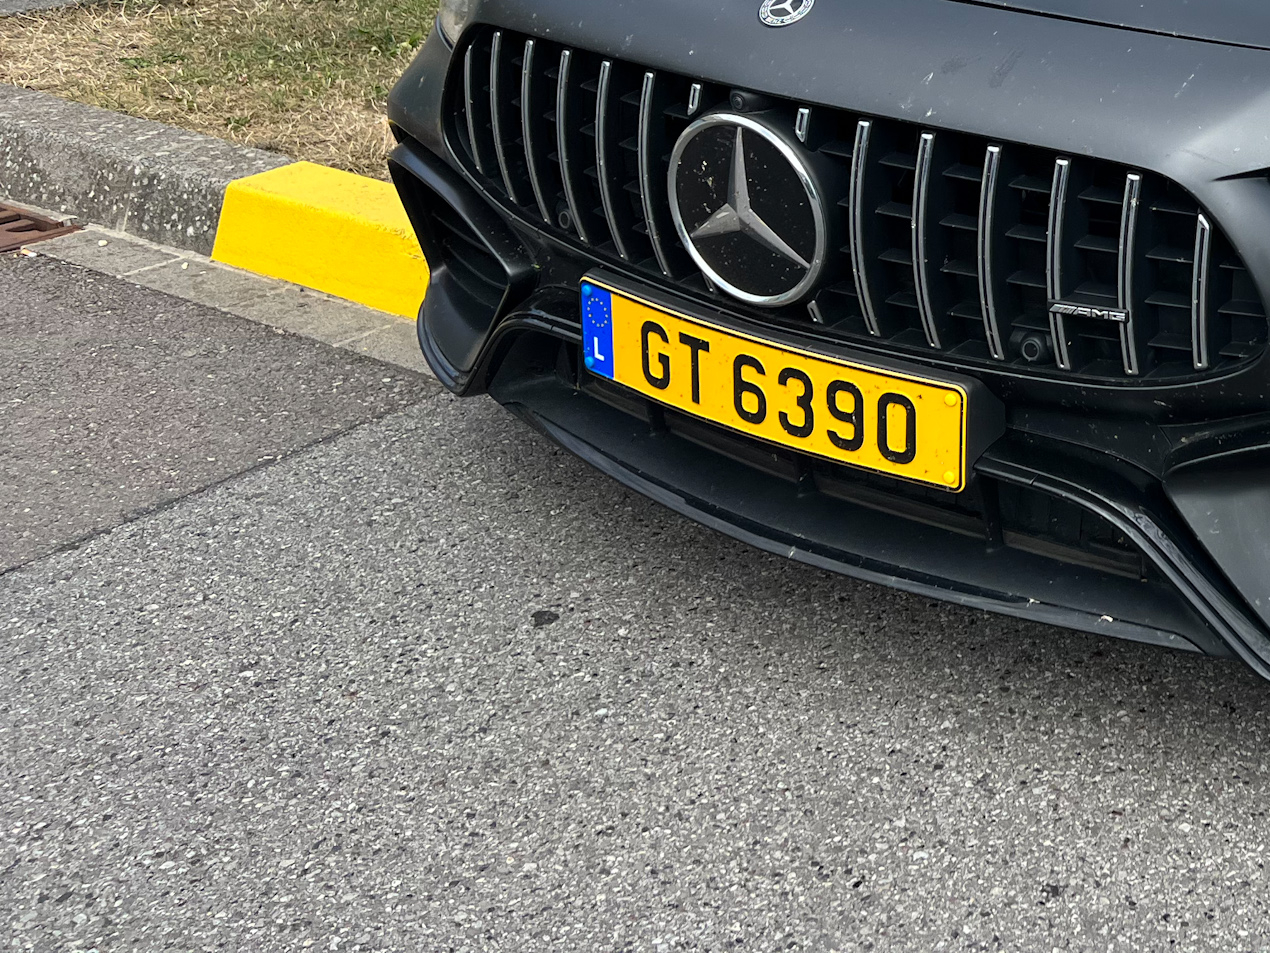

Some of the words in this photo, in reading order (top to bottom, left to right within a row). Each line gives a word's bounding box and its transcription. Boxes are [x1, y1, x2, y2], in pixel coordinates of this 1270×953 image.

[1072, 305, 1126, 323] AMG
[593, 336, 605, 362] L
[640, 320, 710, 405] GT
[733, 353, 917, 465] 6390
